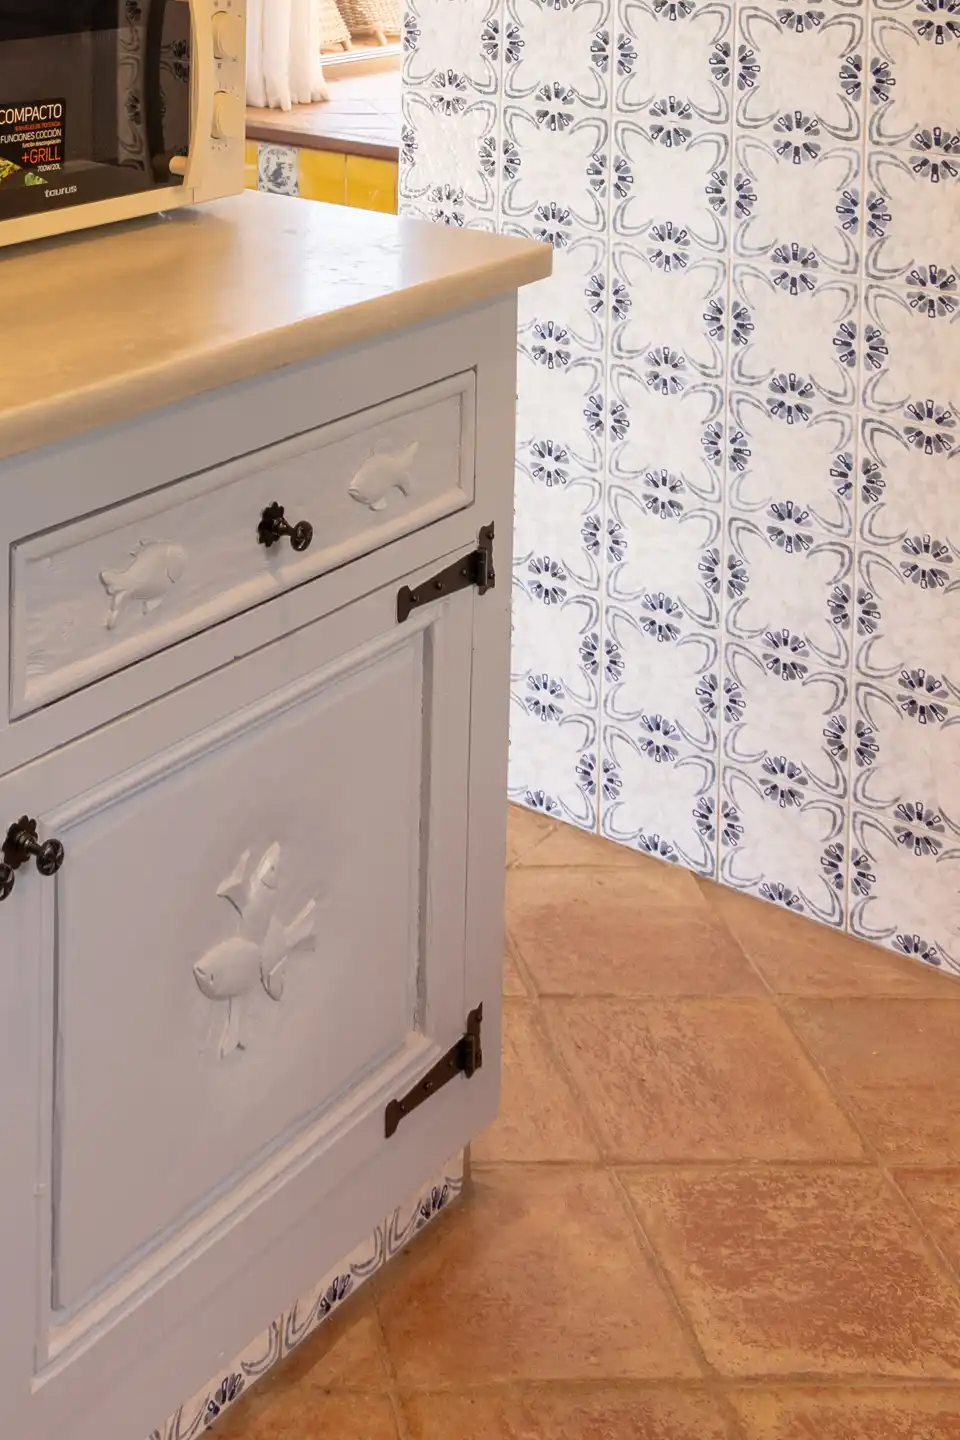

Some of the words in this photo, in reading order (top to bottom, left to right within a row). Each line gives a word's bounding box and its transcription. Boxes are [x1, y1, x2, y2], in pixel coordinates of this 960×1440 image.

[0, 132, 35, 144] FUNCIONES
[21, 146, 61, 164] +GRILL
[44, 185, 77, 198] taurus
